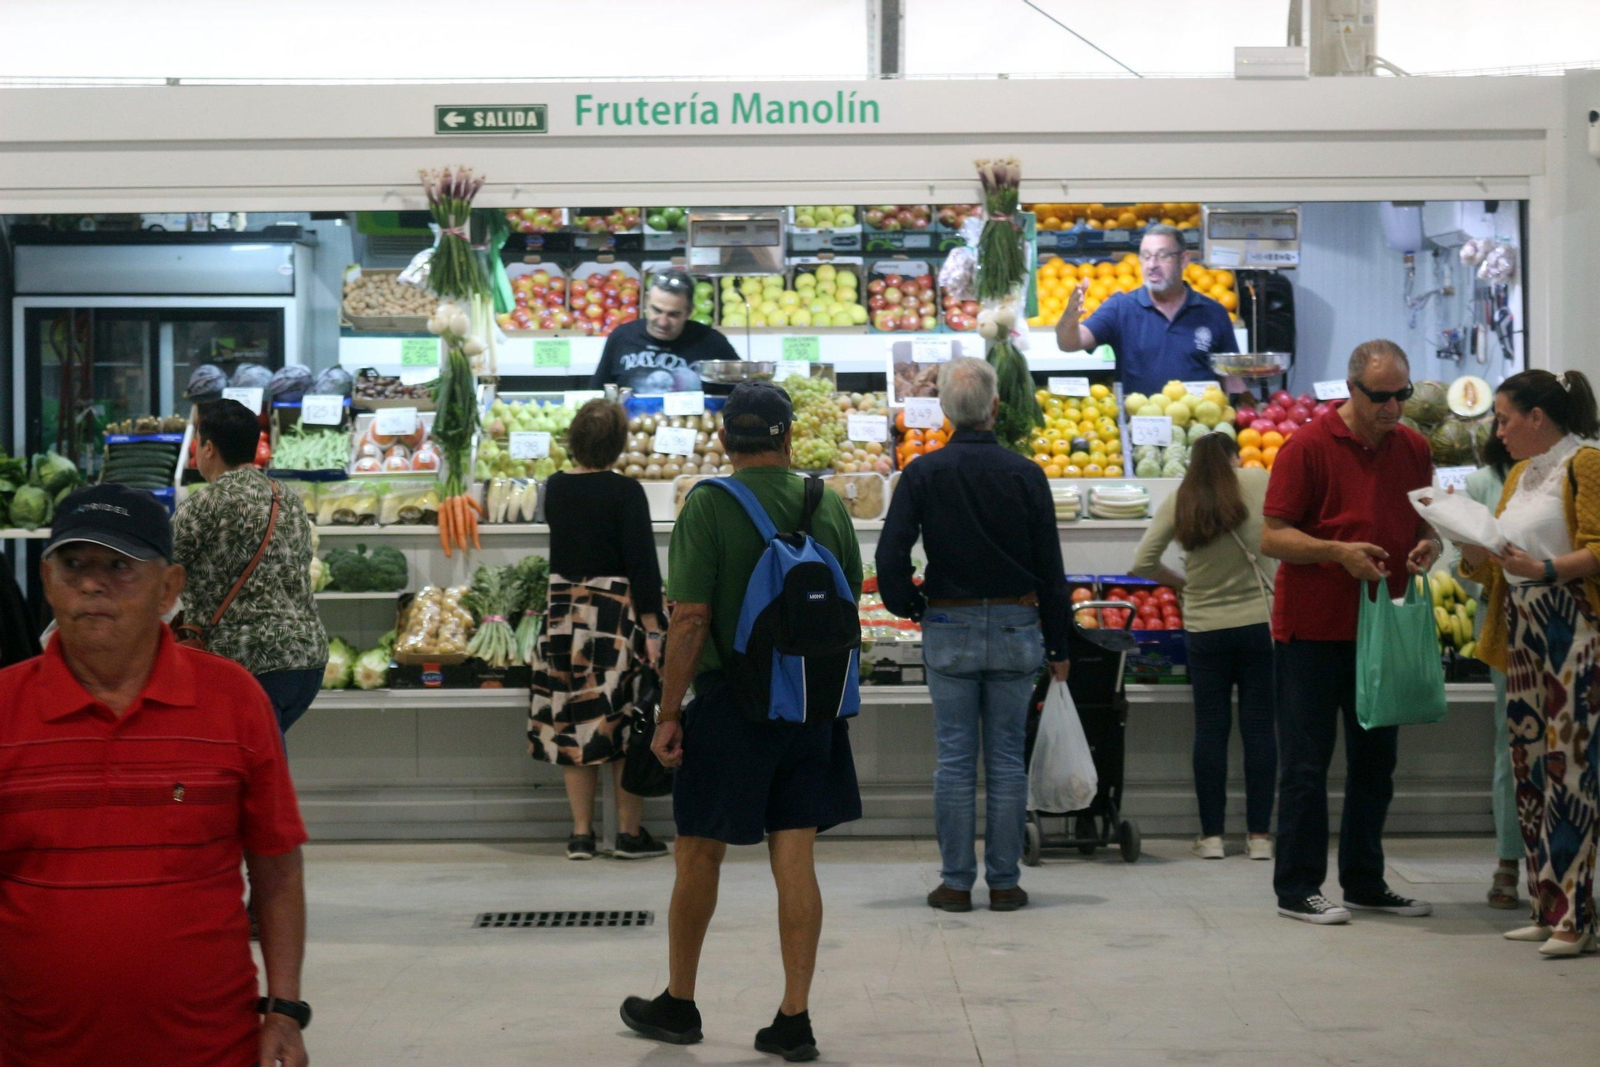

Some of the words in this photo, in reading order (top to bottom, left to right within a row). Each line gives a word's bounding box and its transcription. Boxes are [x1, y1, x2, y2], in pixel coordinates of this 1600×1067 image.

[473, 110, 538, 128] SALIDA
[575, 92, 719, 126] Frutería
[731, 90, 879, 124] Manolín
